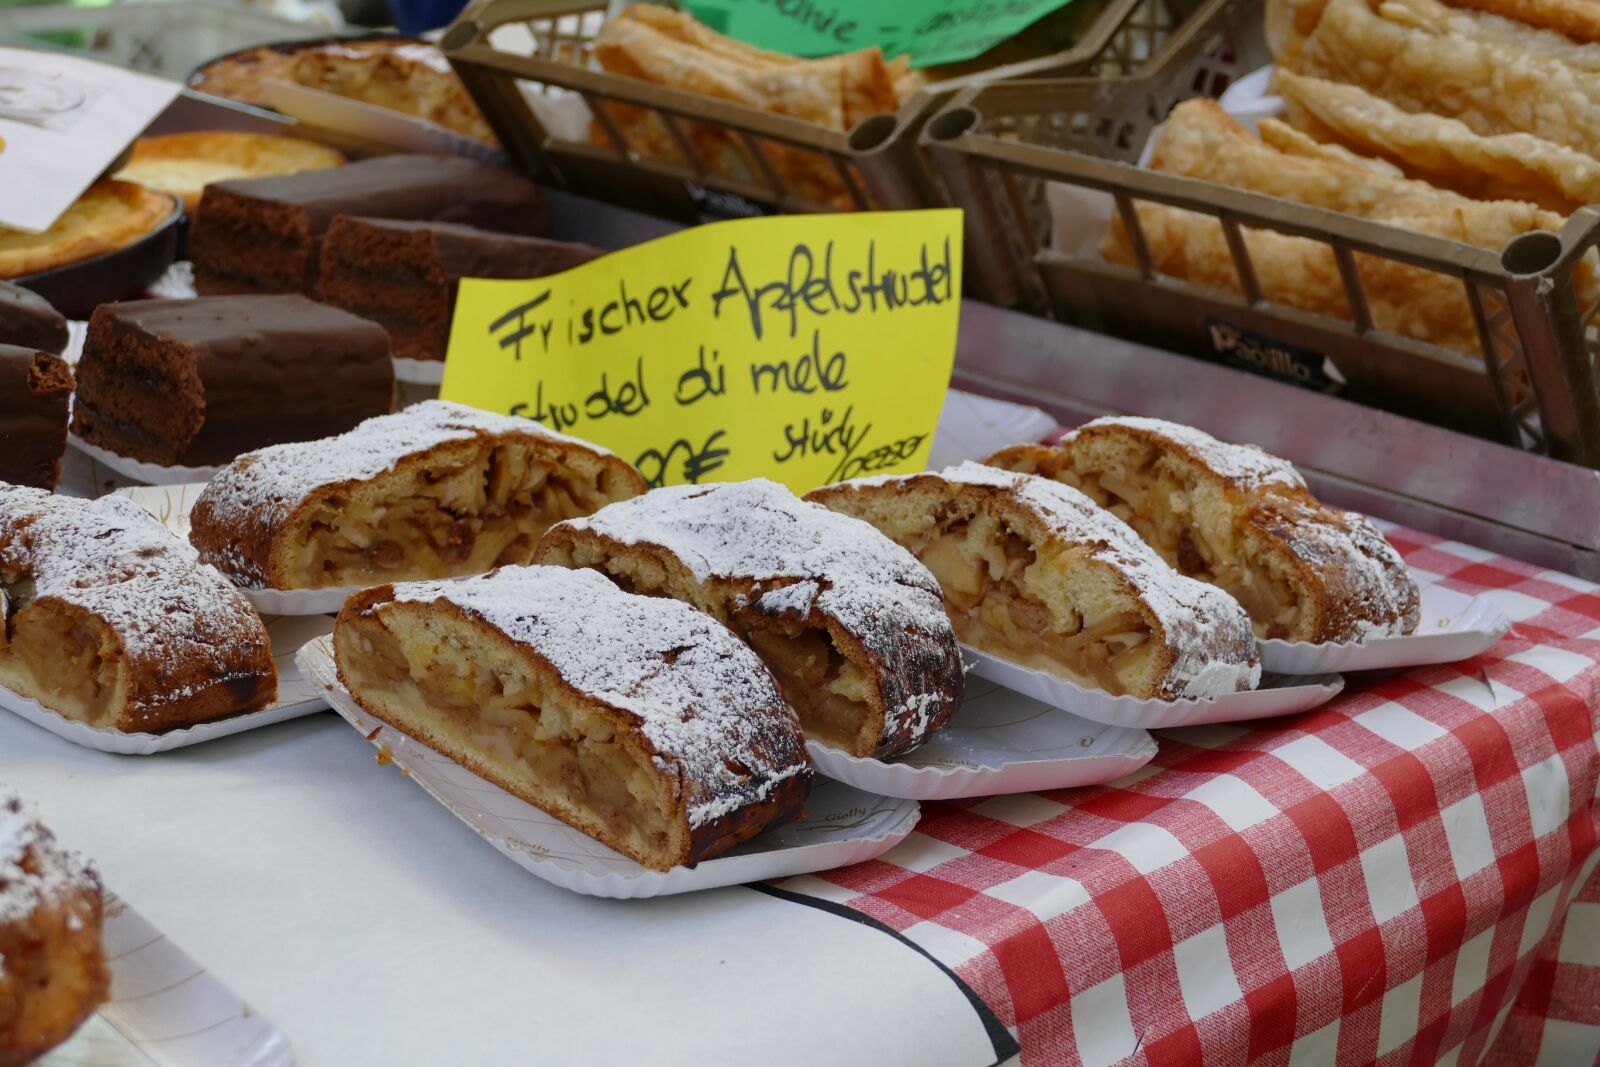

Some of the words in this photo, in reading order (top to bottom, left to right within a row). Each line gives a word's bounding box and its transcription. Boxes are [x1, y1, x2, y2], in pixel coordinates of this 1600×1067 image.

[489, 277, 693, 361] Frischer
[711, 234, 952, 342] Apfelstrudel
[675, 344, 726, 407] di
[751, 328, 849, 395] mele
